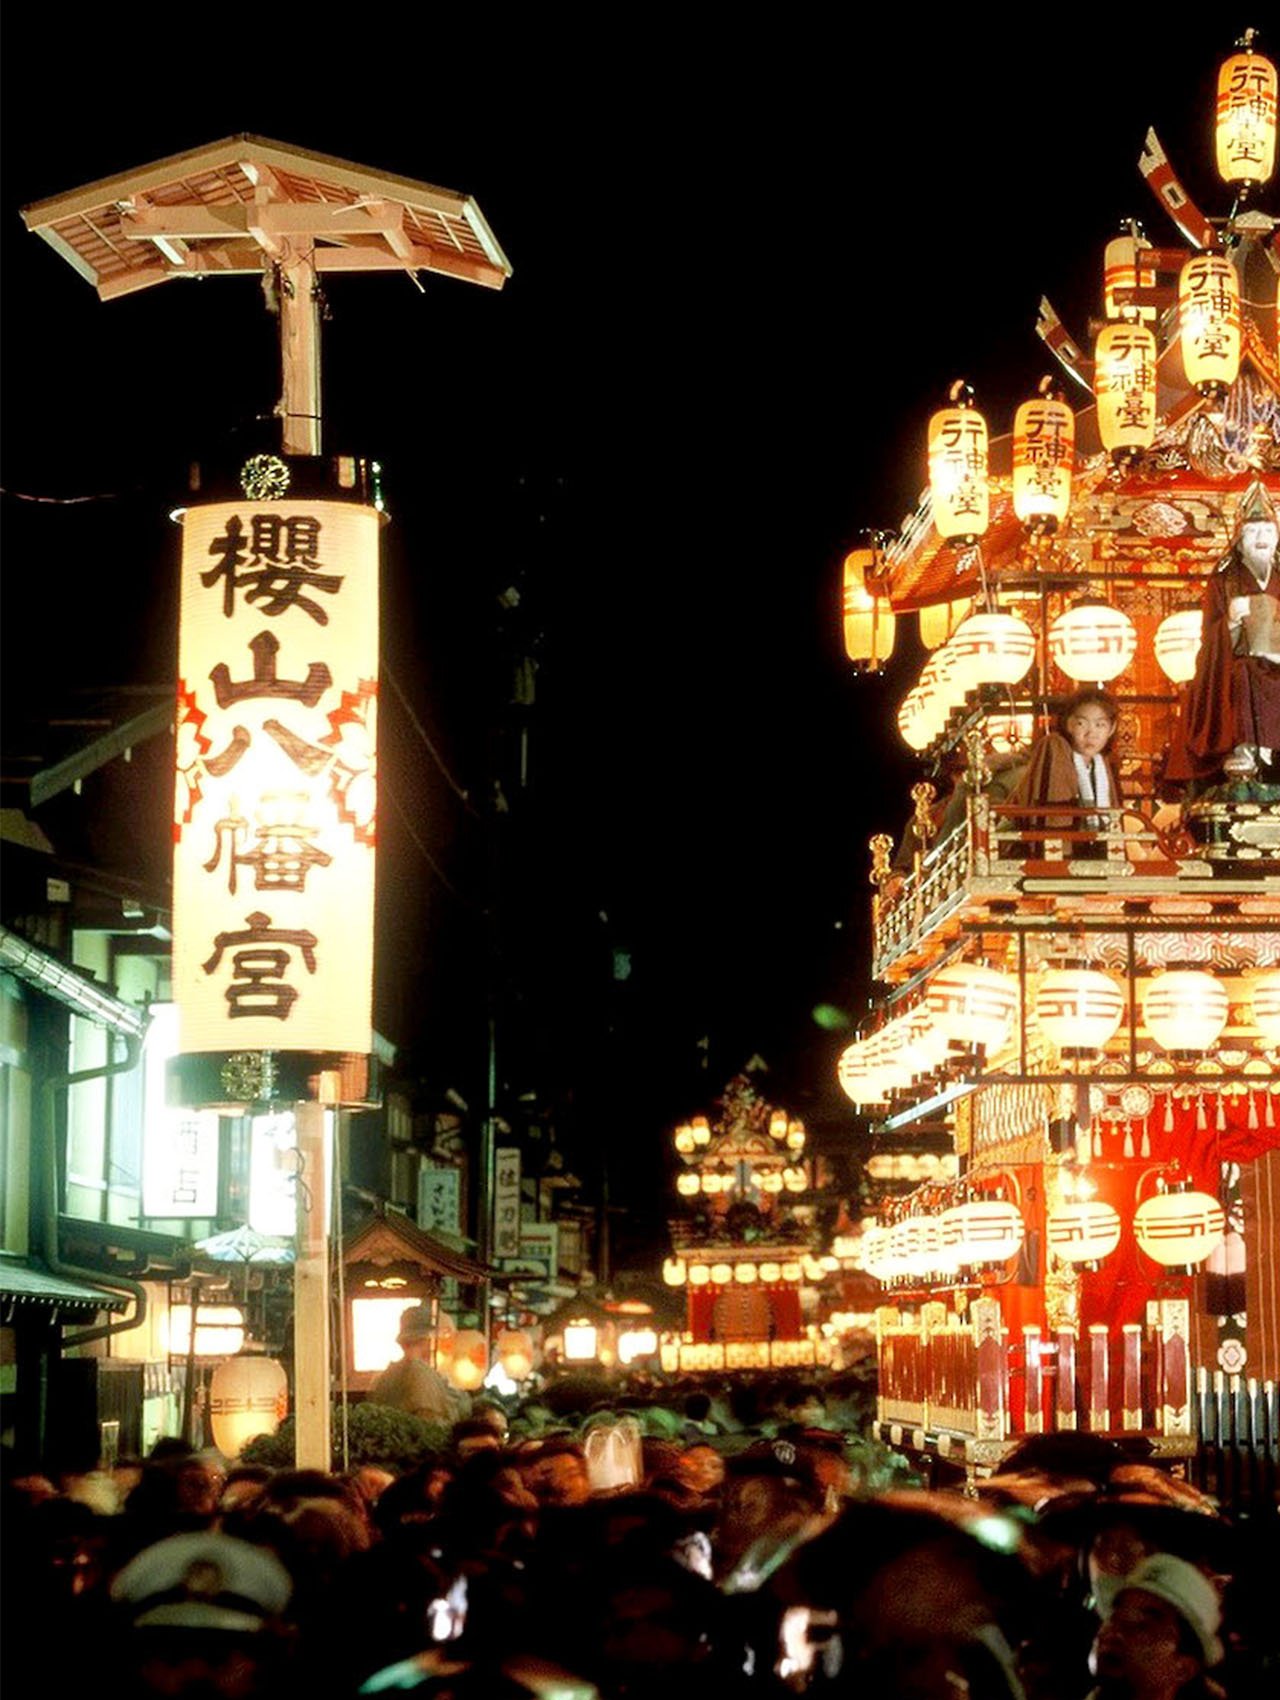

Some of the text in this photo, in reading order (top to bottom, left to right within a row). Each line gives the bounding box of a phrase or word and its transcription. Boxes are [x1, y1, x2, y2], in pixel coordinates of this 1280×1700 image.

[198, 513, 346, 1022] 櫻山八幡宮
